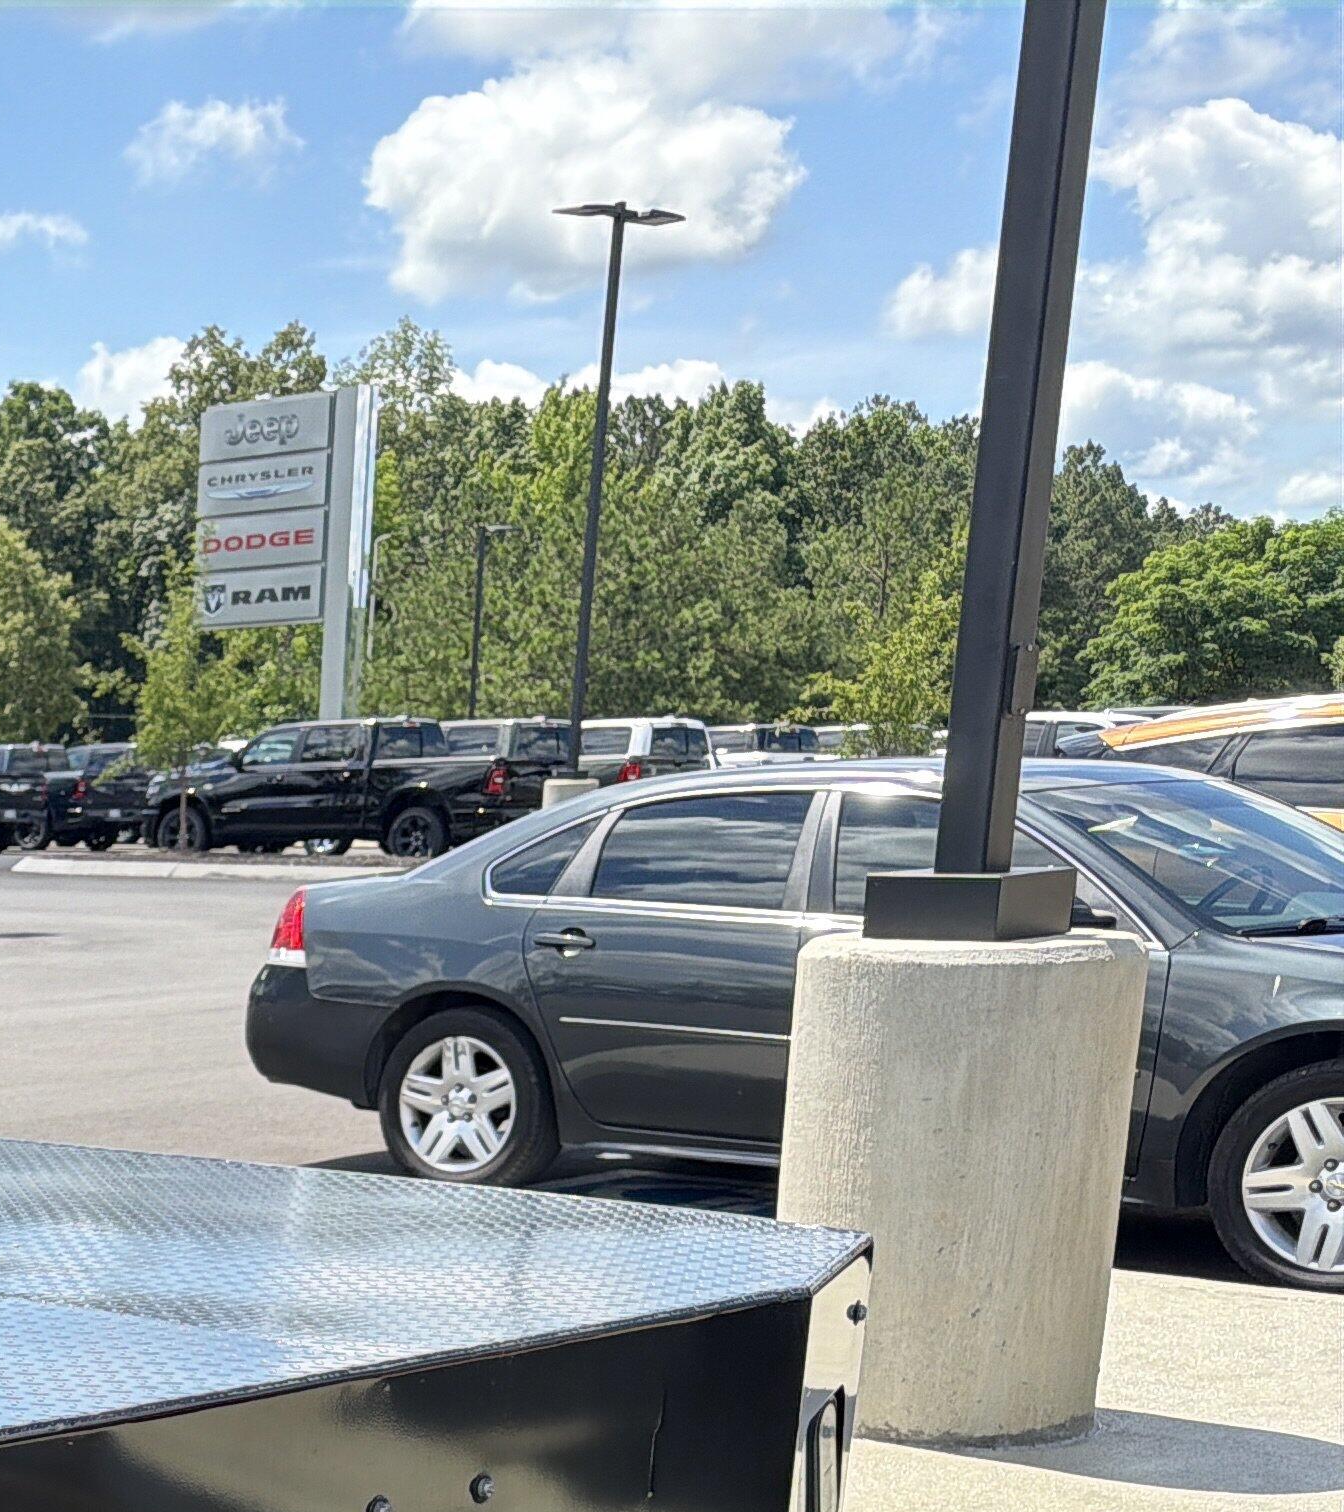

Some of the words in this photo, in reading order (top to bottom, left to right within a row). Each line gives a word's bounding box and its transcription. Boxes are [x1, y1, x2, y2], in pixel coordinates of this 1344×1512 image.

[225, 413, 299, 446] Jeep
[207, 465, 314, 487] CHRYSLER
[202, 528, 315, 555] DODGE
[231, 585, 311, 606] RAM
